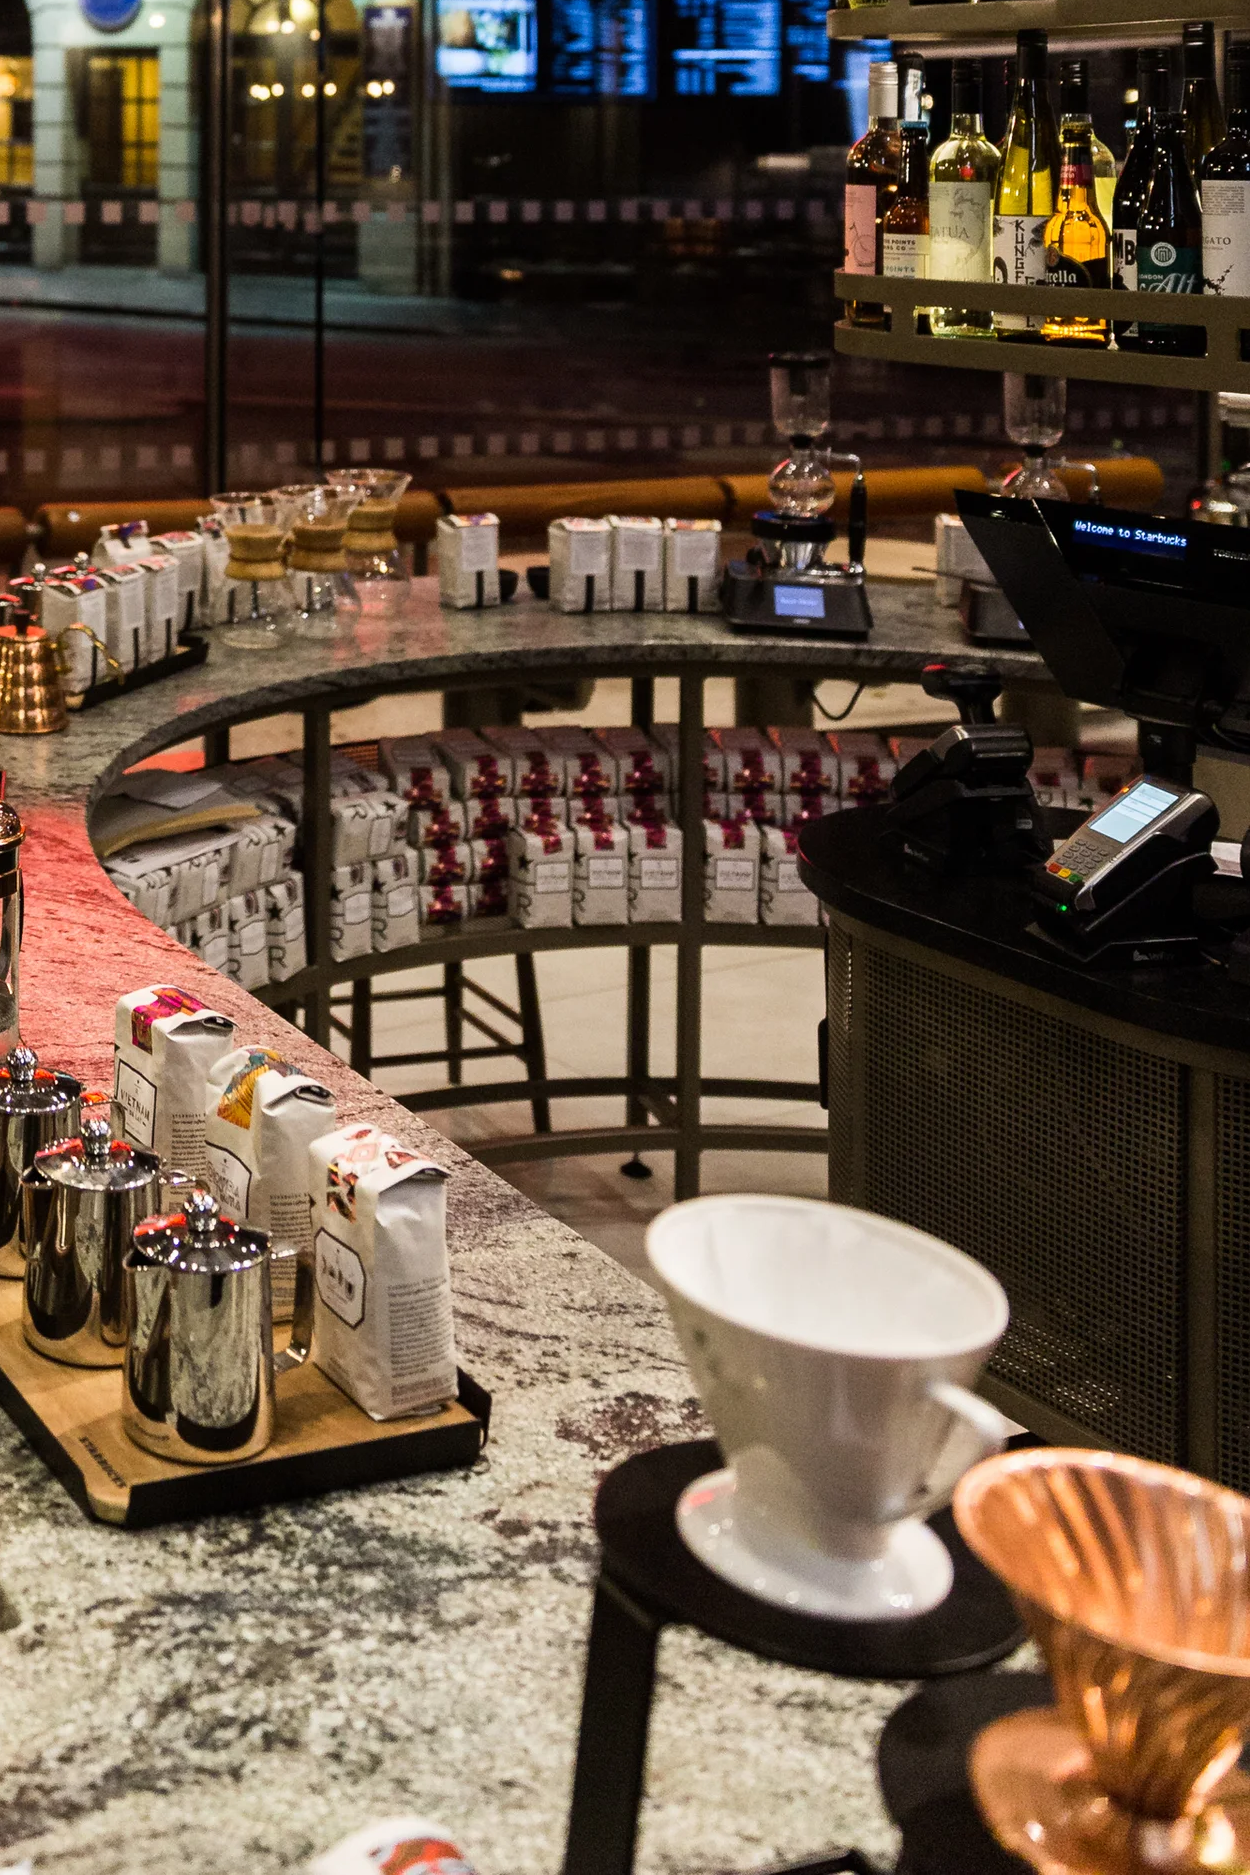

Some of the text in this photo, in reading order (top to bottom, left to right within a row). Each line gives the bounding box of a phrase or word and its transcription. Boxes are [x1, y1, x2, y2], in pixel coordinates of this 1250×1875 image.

[1074, 520, 1187, 547] Welcome to Starbucks
[1213, 548, 1250, 562] TOSHIB
[120, 1088, 150, 1121] VIETNAM
